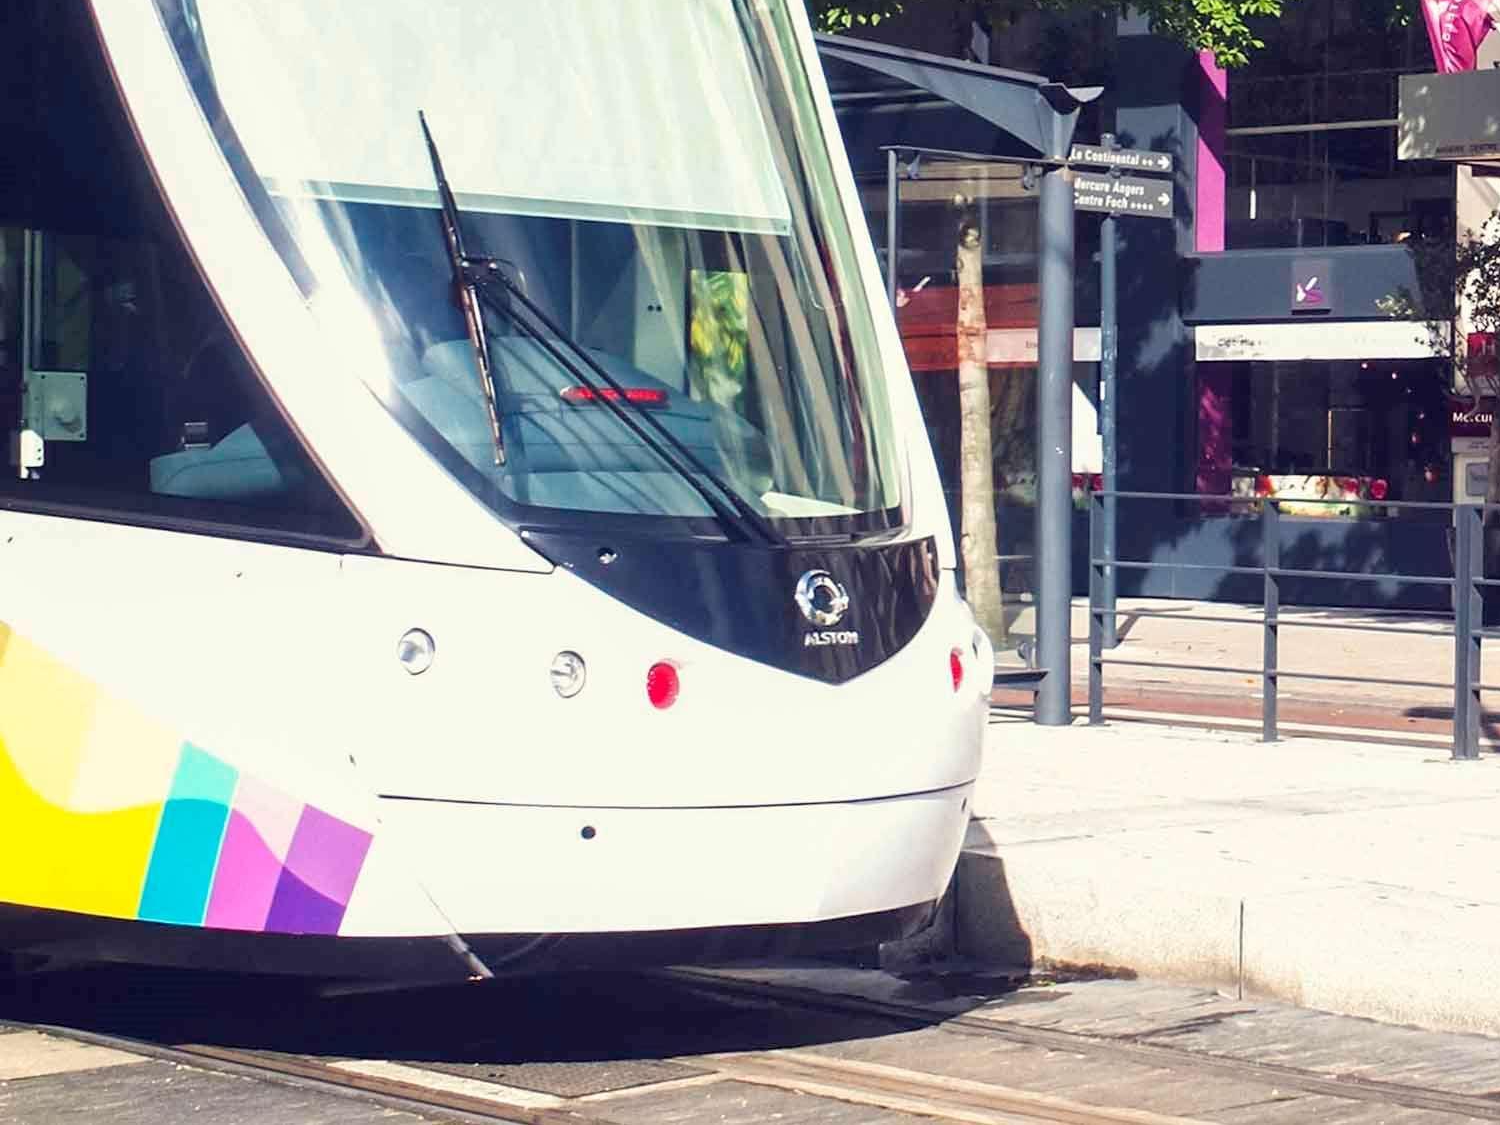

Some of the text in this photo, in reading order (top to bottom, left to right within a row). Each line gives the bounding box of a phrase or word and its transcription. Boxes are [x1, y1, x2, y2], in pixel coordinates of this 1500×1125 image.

[1071, 148, 1139, 165] Le Continental
[1112, 181, 1145, 197] Angers
[1105, 195, 1128, 209] Foch
[804, 631, 859, 647] ALSTOM
